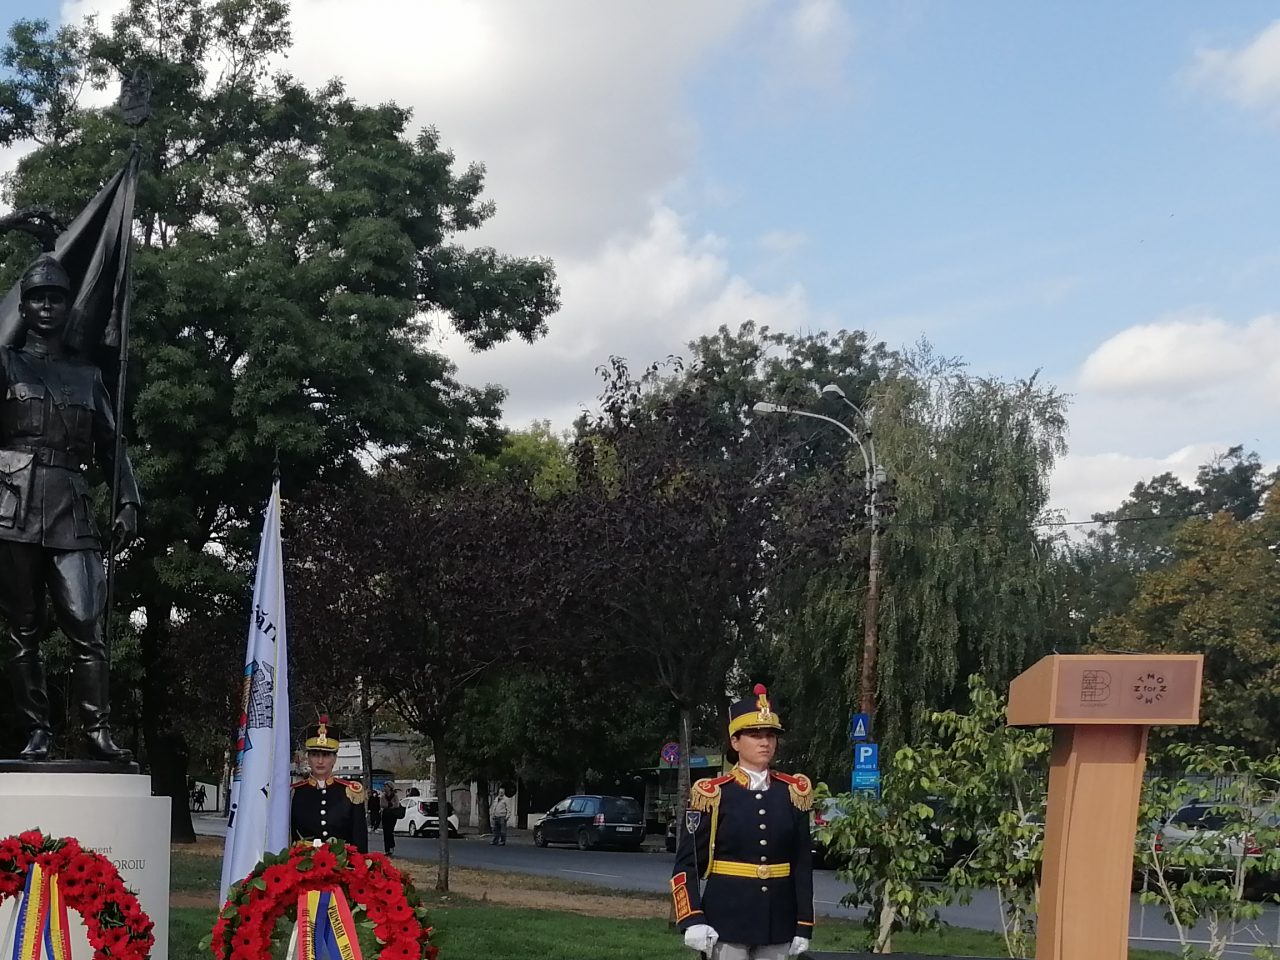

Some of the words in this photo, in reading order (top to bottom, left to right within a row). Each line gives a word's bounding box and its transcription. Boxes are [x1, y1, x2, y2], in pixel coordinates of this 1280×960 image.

[860, 747, 872, 763] P
[112, 859, 146, 870] OROIU
[328, 904, 346, 940] PRIMARIA
